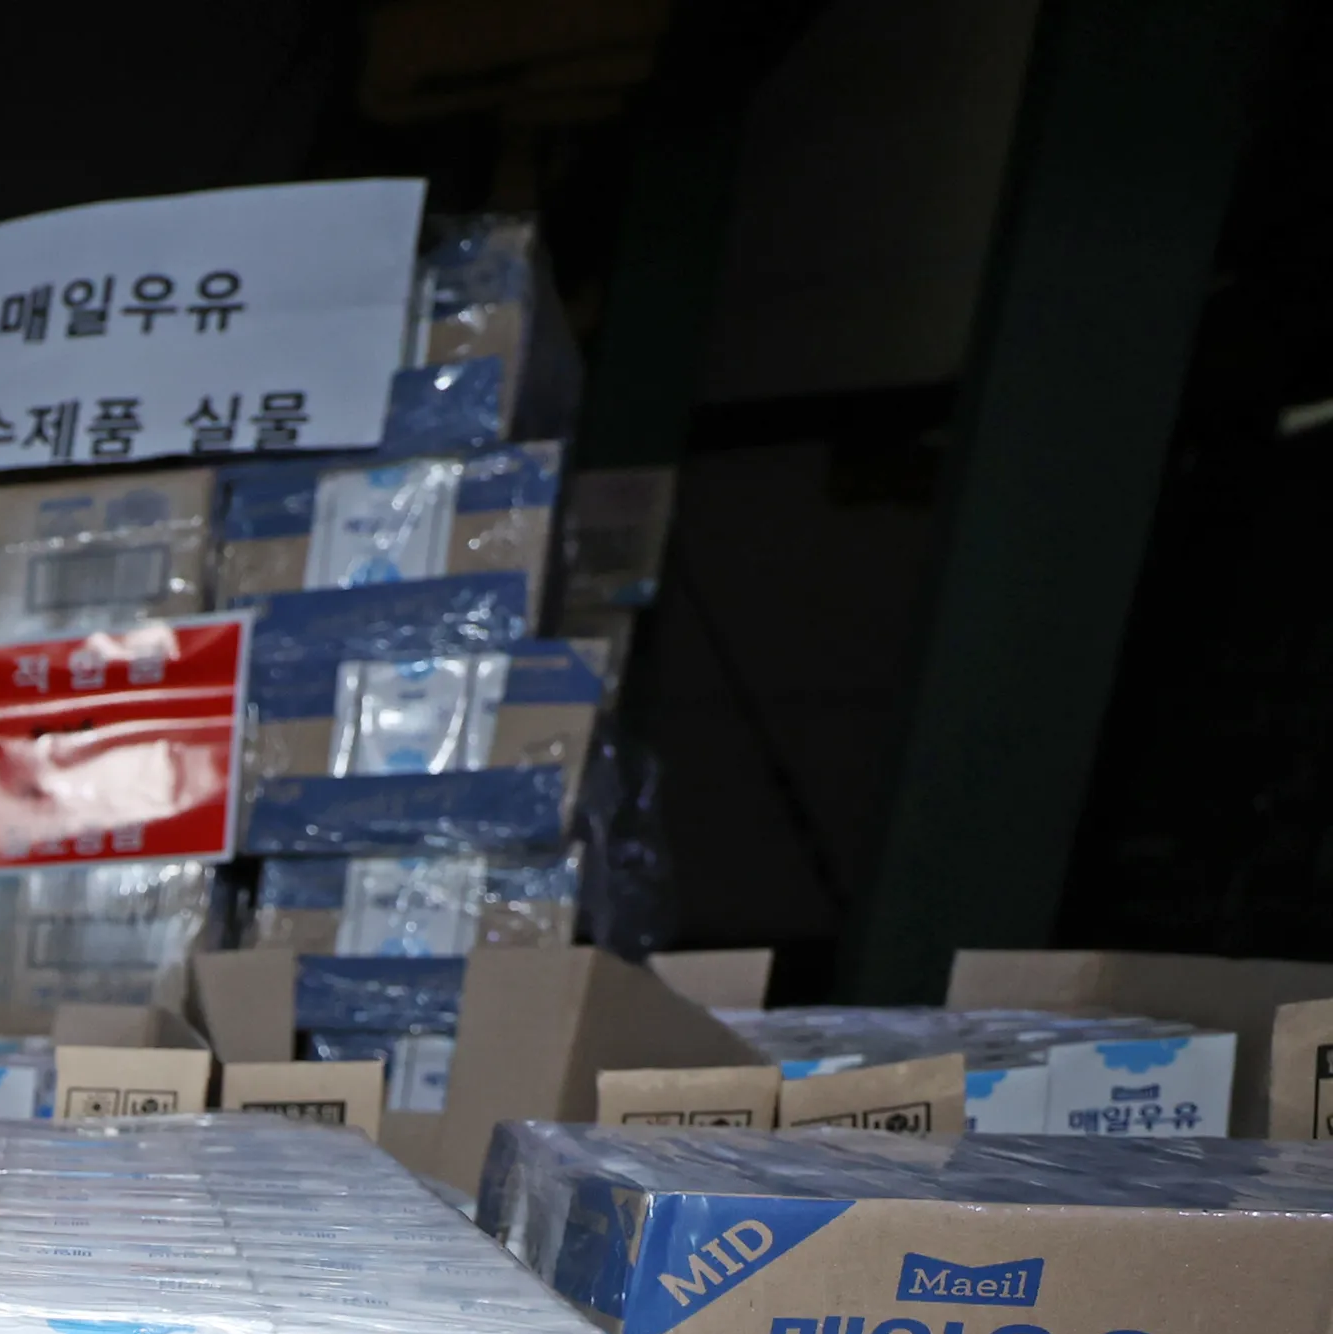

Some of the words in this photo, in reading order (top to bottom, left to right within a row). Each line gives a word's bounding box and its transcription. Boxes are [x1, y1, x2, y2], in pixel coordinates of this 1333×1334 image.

[182, 390, 310, 452] 실물
[1068, 1103, 1203, 1132] 매일우유
[656, 1218, 776, 1308] MID
[907, 1269, 1028, 1300] Maeil
